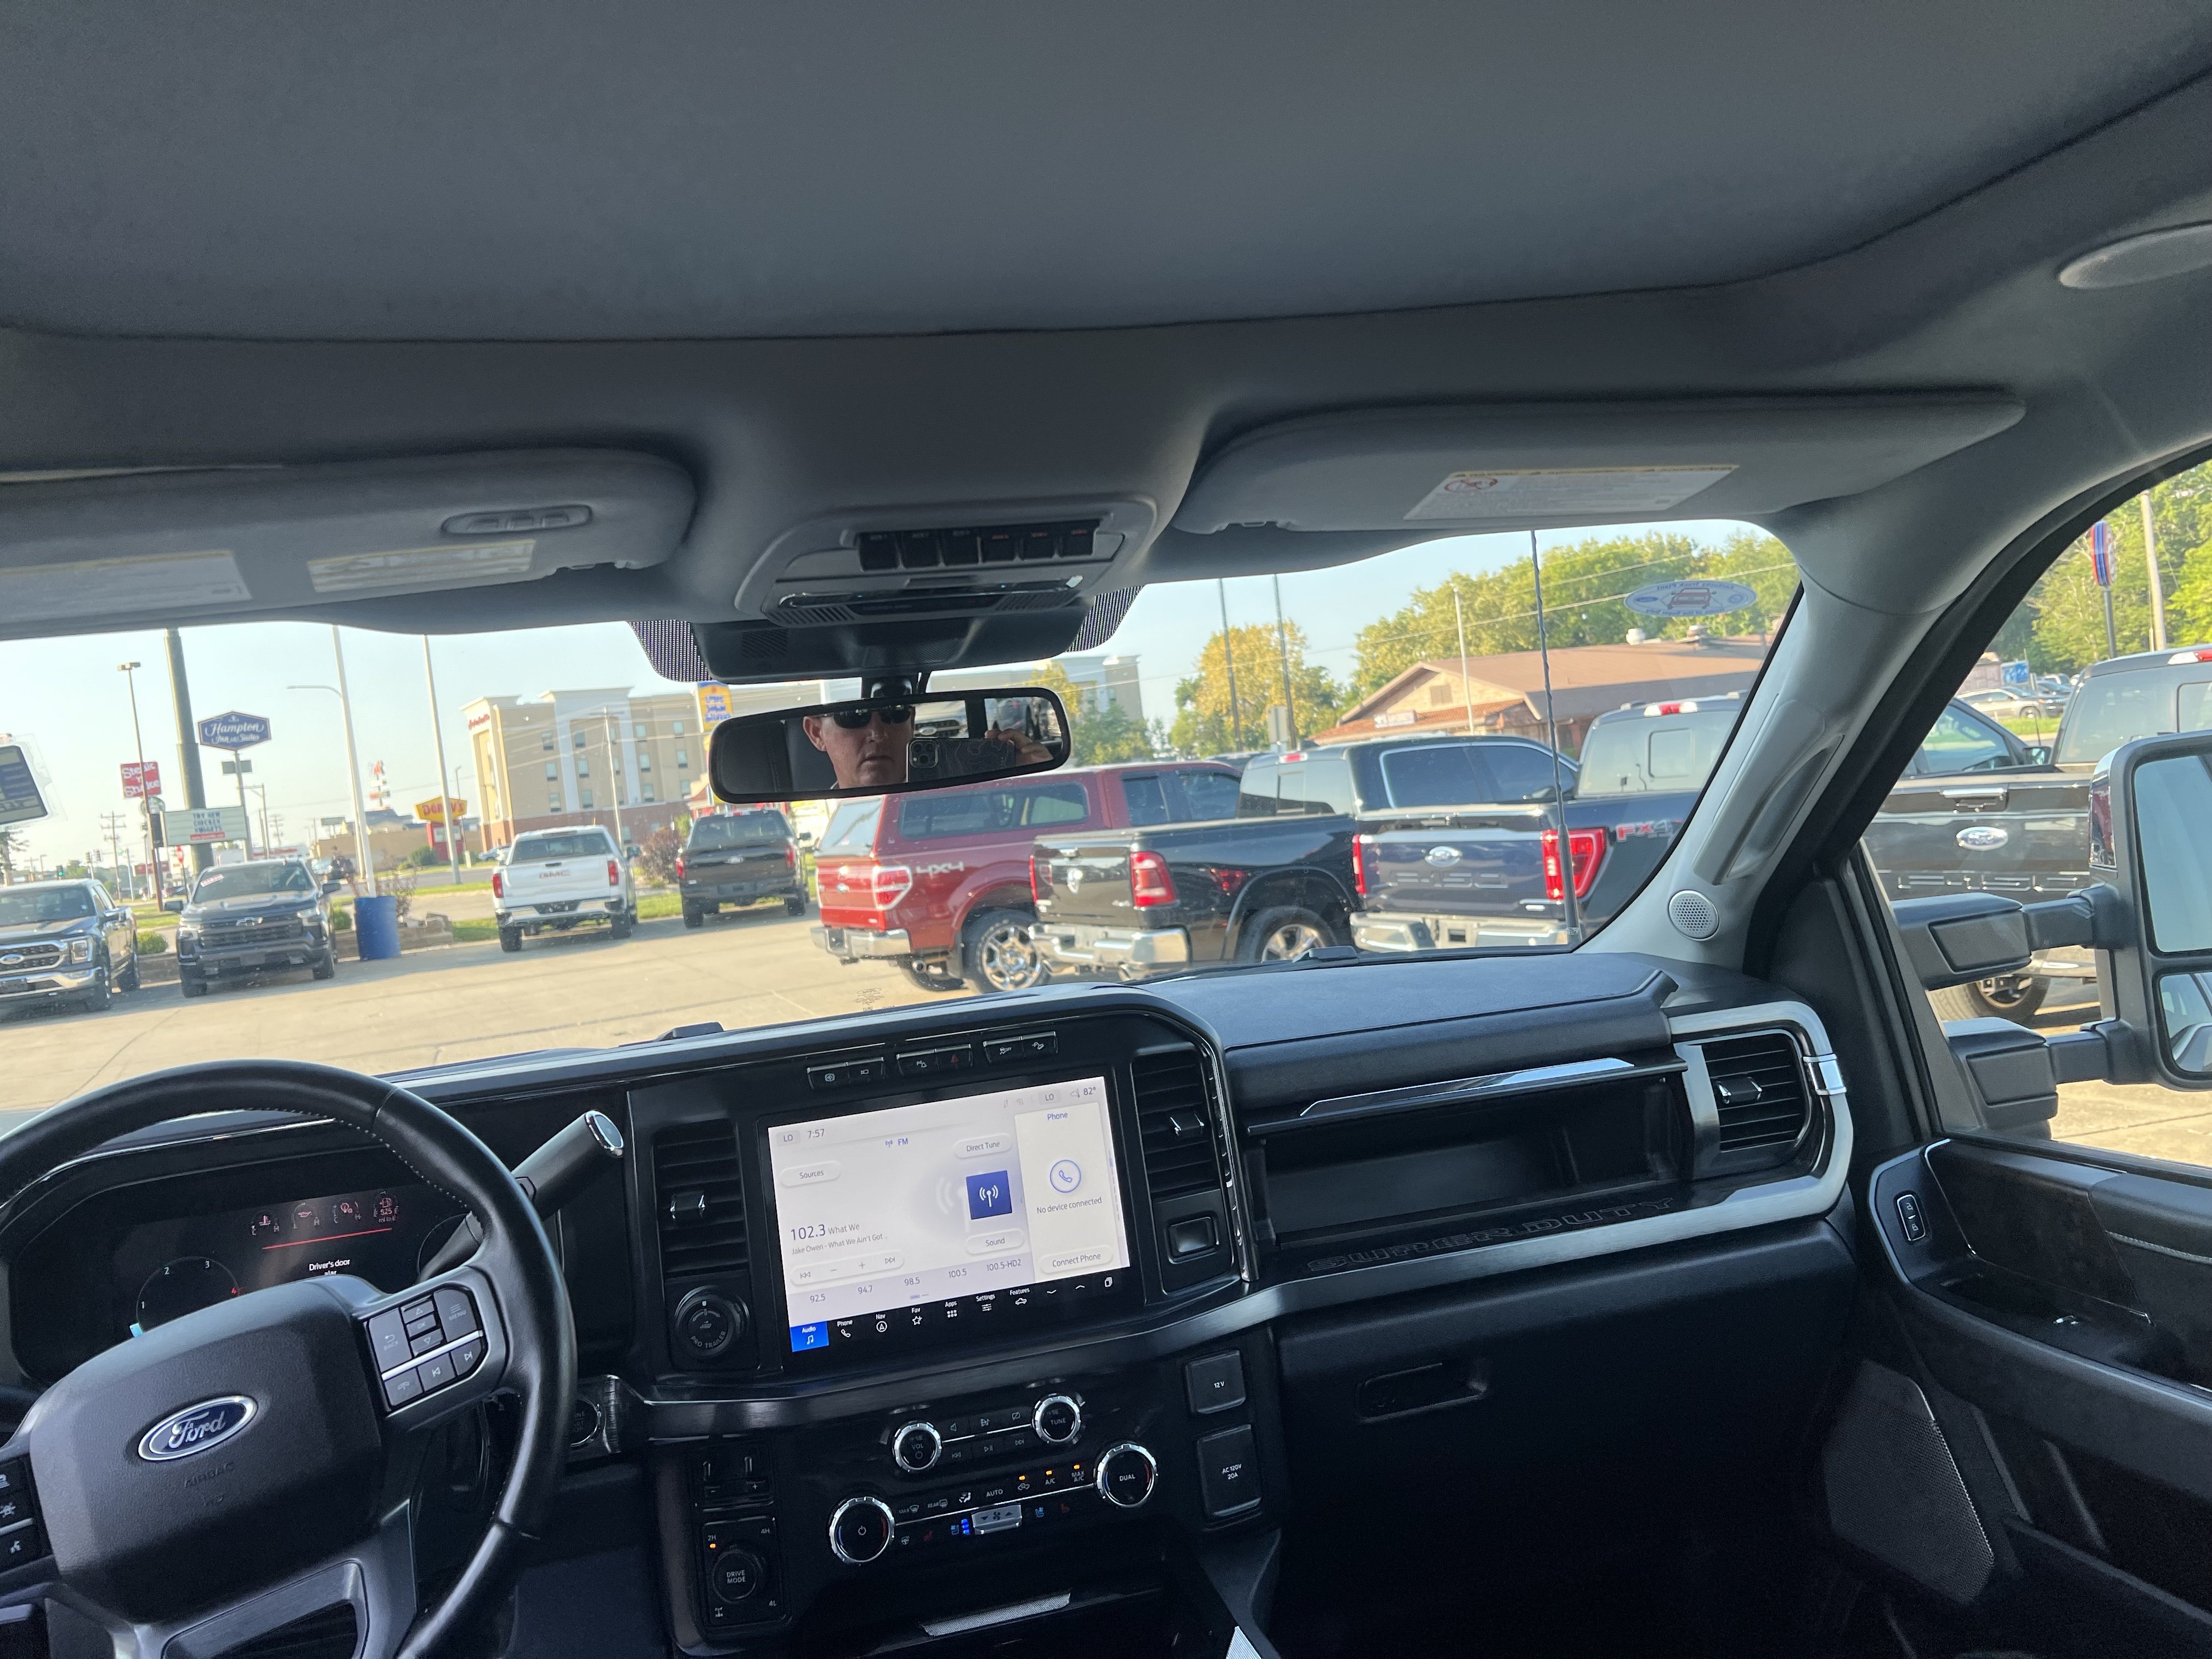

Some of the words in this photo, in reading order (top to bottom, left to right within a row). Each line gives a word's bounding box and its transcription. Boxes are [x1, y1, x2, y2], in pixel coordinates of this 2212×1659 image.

[205, 722, 264, 737] Hampton
[212, 735, 230, 744] Inn
[122, 763, 156, 778] Stek
[123, 780, 160, 797] Shke
[1047, 1112, 1068, 1120] Phone
[783, 1133, 793, 1142] LO
[807, 1128, 825, 1139] 7:57
[898, 1138, 909, 1146] FM
[966, 1143, 984, 1152] Direct
[799, 1170, 824, 1179] Sources
[1047, 1203, 1068, 1212] device
[1069, 1197, 1102, 1209] connected
[791, 1224, 826, 1240] 102.3
[828, 1226, 847, 1235] What
[849, 1223, 860, 1232] We
[1307, 1228, 1513, 1271] SUPER
[1522, 1198, 1673, 1232] DUTY
[856, 1235, 871, 1244] Ain't
[985, 1237, 1005, 1246] Sound
[205, 1260, 210, 1268] 3
[1052, 1256, 1079, 1267] Connect
[1080, 1253, 1101, 1262] Phone
[164, 1266, 170, 1275] 2
[309, 1261, 334, 1271] Driver's
[810, 1294, 826, 1303] 92.5
[857, 1285, 873, 1294] 94.7
[904, 1277, 920, 1285] 98.5
[949, 1268, 967, 1278] 100.5
[987, 1259, 1021, 1271] 100.5-HD2
[1009, 1287, 1030, 1295] Features
[976, 1293, 996, 1302] Settings
[141, 1301, 145, 1309] 1
[690, 1335, 703, 1347] PRO
[706, 1331, 726, 1348] TRAILER
[168, 1410, 225, 1448] Ford
[986, 1488, 1003, 1497] AUTO
[726, 1570, 745, 1578] DRIVE
[727, 1576, 746, 1584] MODE
